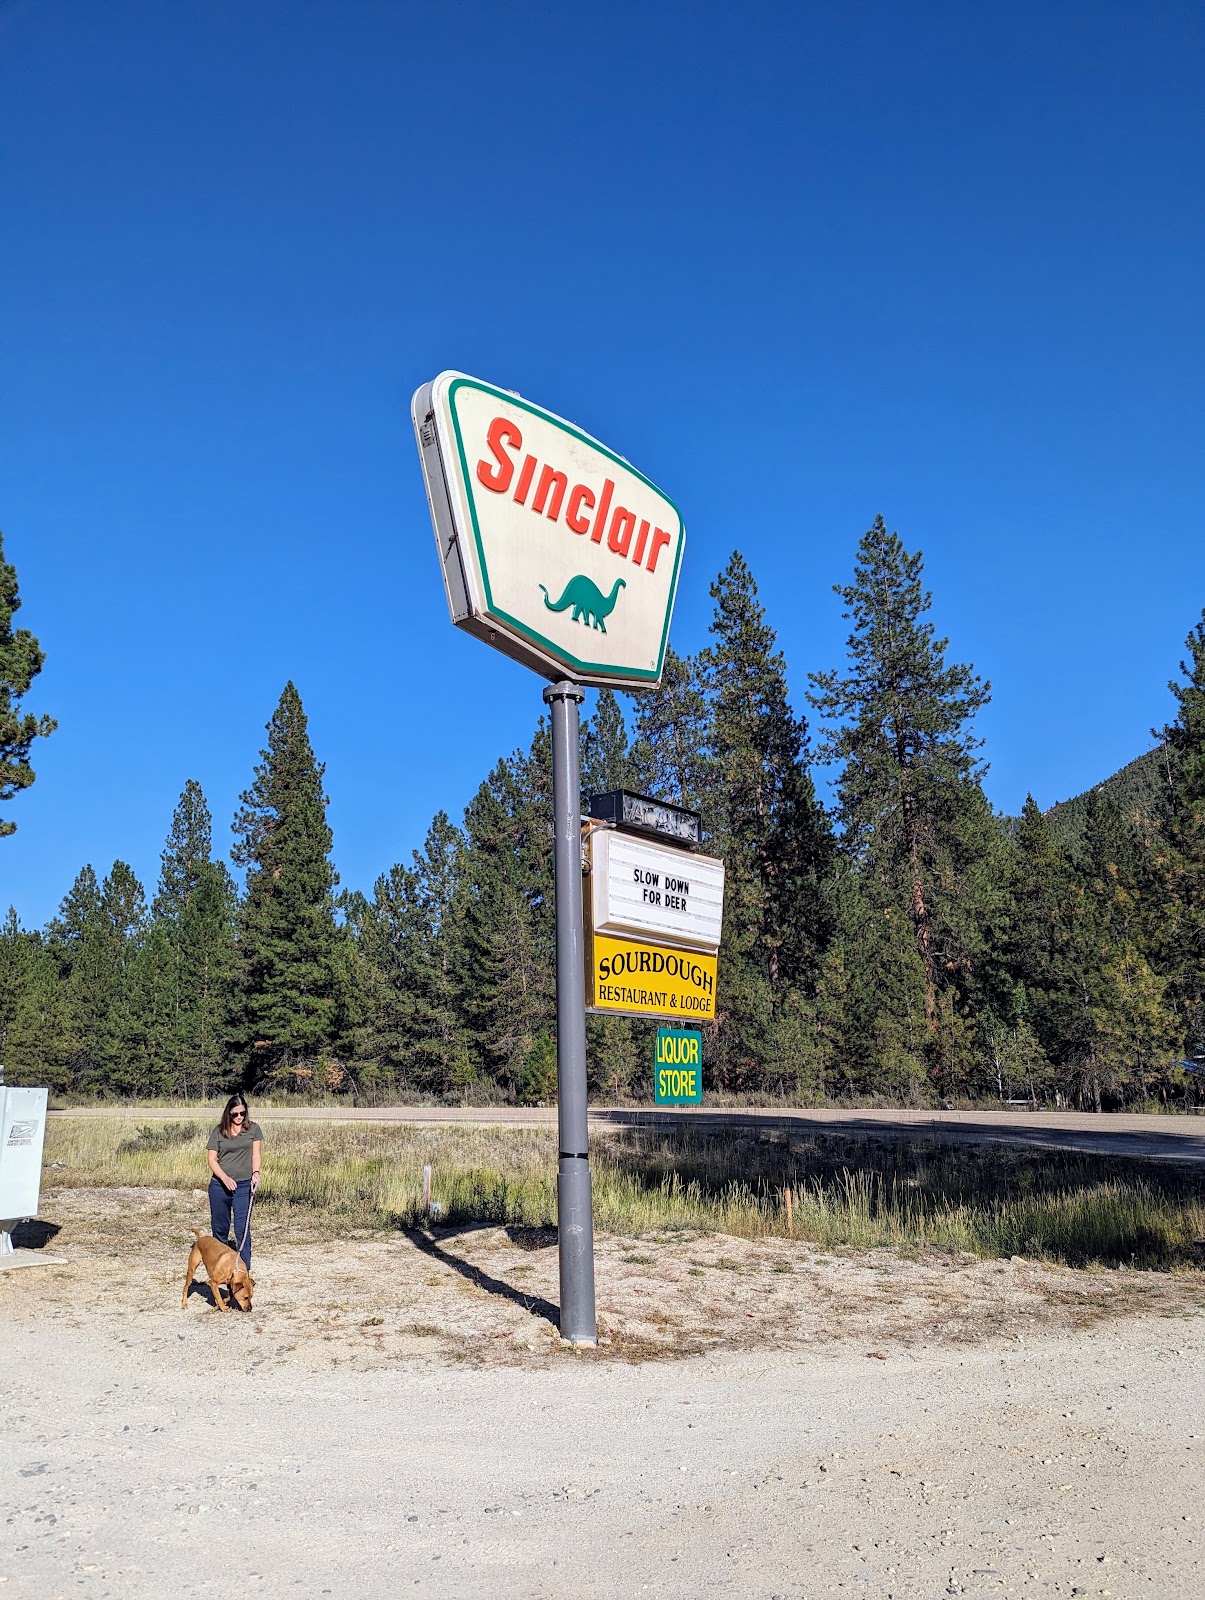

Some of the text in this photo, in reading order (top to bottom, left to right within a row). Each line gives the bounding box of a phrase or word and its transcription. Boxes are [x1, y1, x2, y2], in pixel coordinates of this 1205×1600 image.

[476, 416, 671, 574] Sinclair
[633, 868, 690, 895] SLOW DOWN
[643, 888, 687, 912] FOR DEER
[599, 951, 713, 996] SOURDOUGH
[599, 984, 712, 1012] RESTAURANT & LODGE
[657, 1036, 699, 1064] LIQUOR
[659, 1069, 697, 1097] STORE
